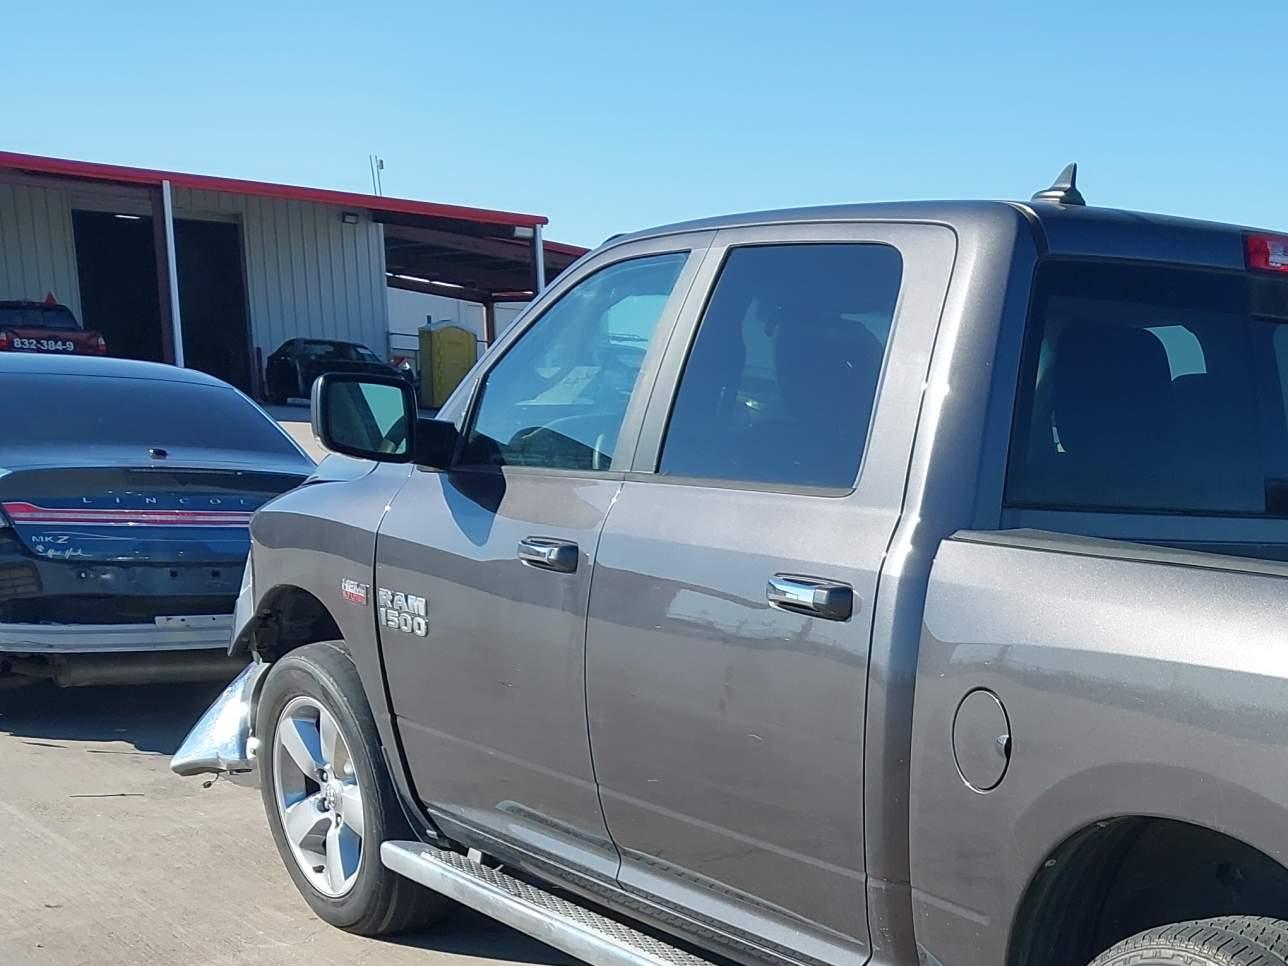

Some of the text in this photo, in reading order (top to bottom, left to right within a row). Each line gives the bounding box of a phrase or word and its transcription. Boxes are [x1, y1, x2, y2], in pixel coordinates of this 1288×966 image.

[13, 337, 75, 351] 832-384-9
[378, 587, 427, 616] RAM
[379, 607, 429, 637] 1500
